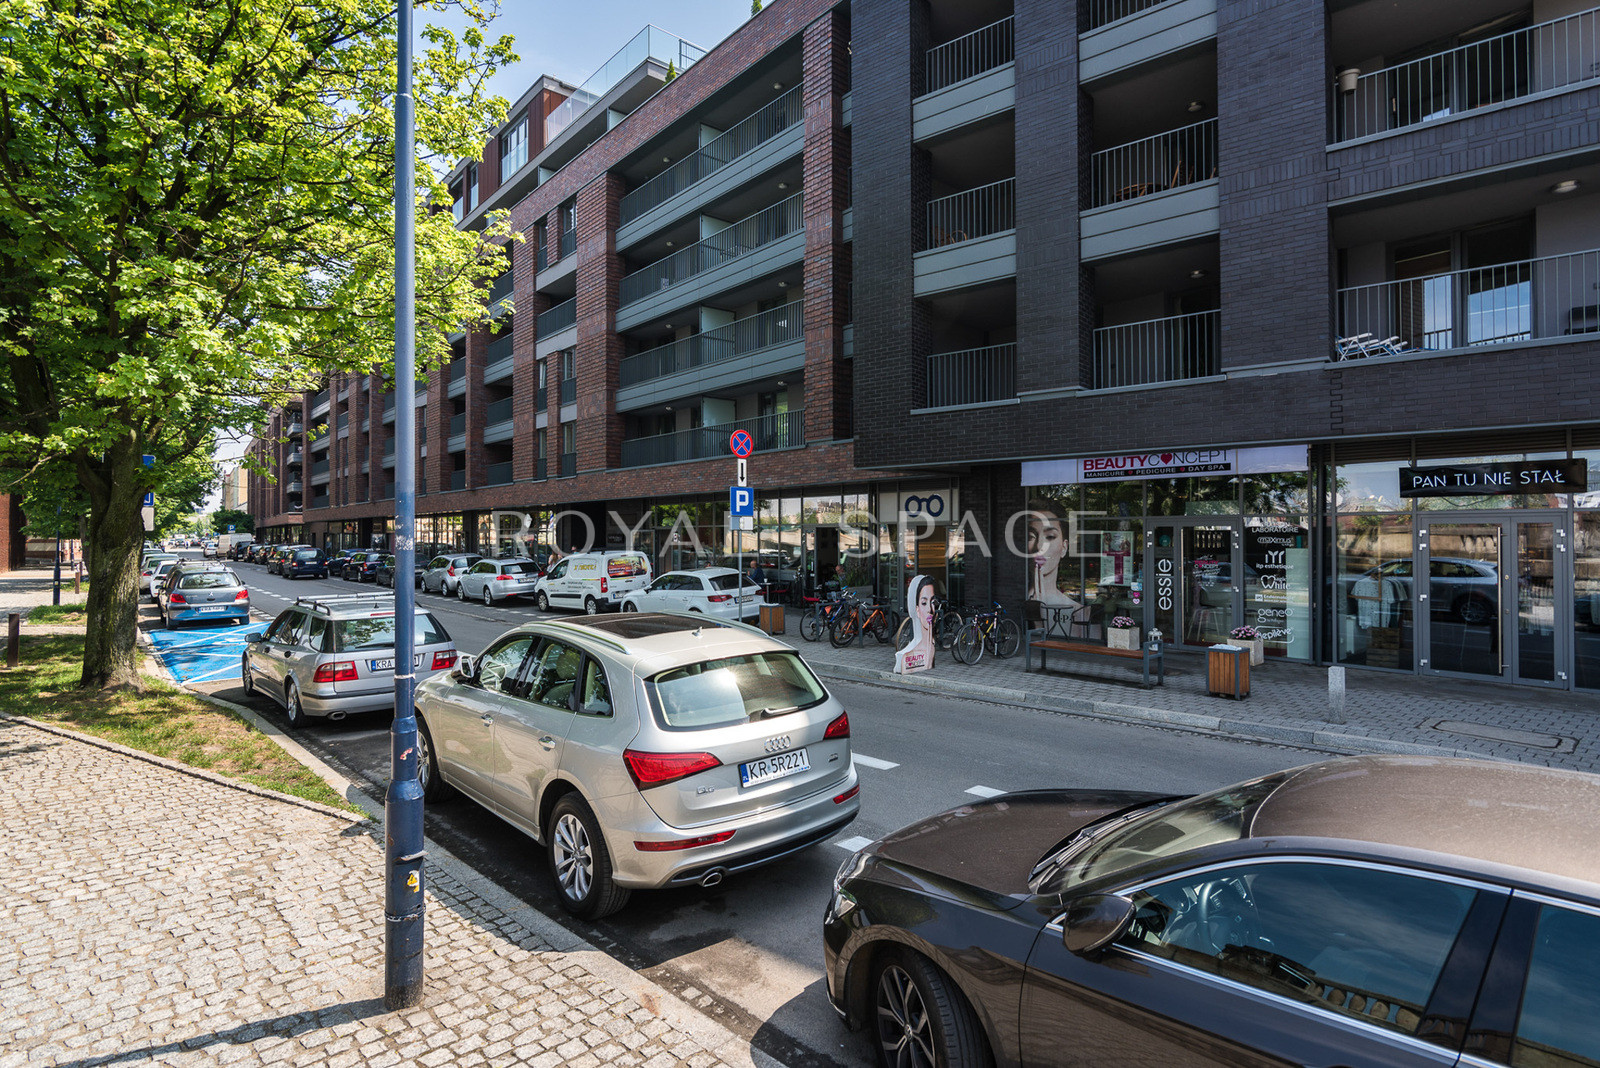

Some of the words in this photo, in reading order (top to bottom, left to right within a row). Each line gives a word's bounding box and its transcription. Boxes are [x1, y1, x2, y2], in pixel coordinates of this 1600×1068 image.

[1086, 470, 1125, 478] MANICURE
[1136, 467, 1176, 475] PEDICURE
[1413, 475, 1446, 488] PAN
[1454, 473, 1476, 486] TU
[1484, 471, 1511, 485] NIE
[1519, 469, 1565, 484] STAŁ
[736, 490, 749, 512] P
[1155, 558, 1172, 611] essie
[376, 660, 392, 669] KRA
[905, 654, 924, 663] BEAUTY
[749, 763, 767, 780] KR
[772, 751, 806, 773] 5R221
